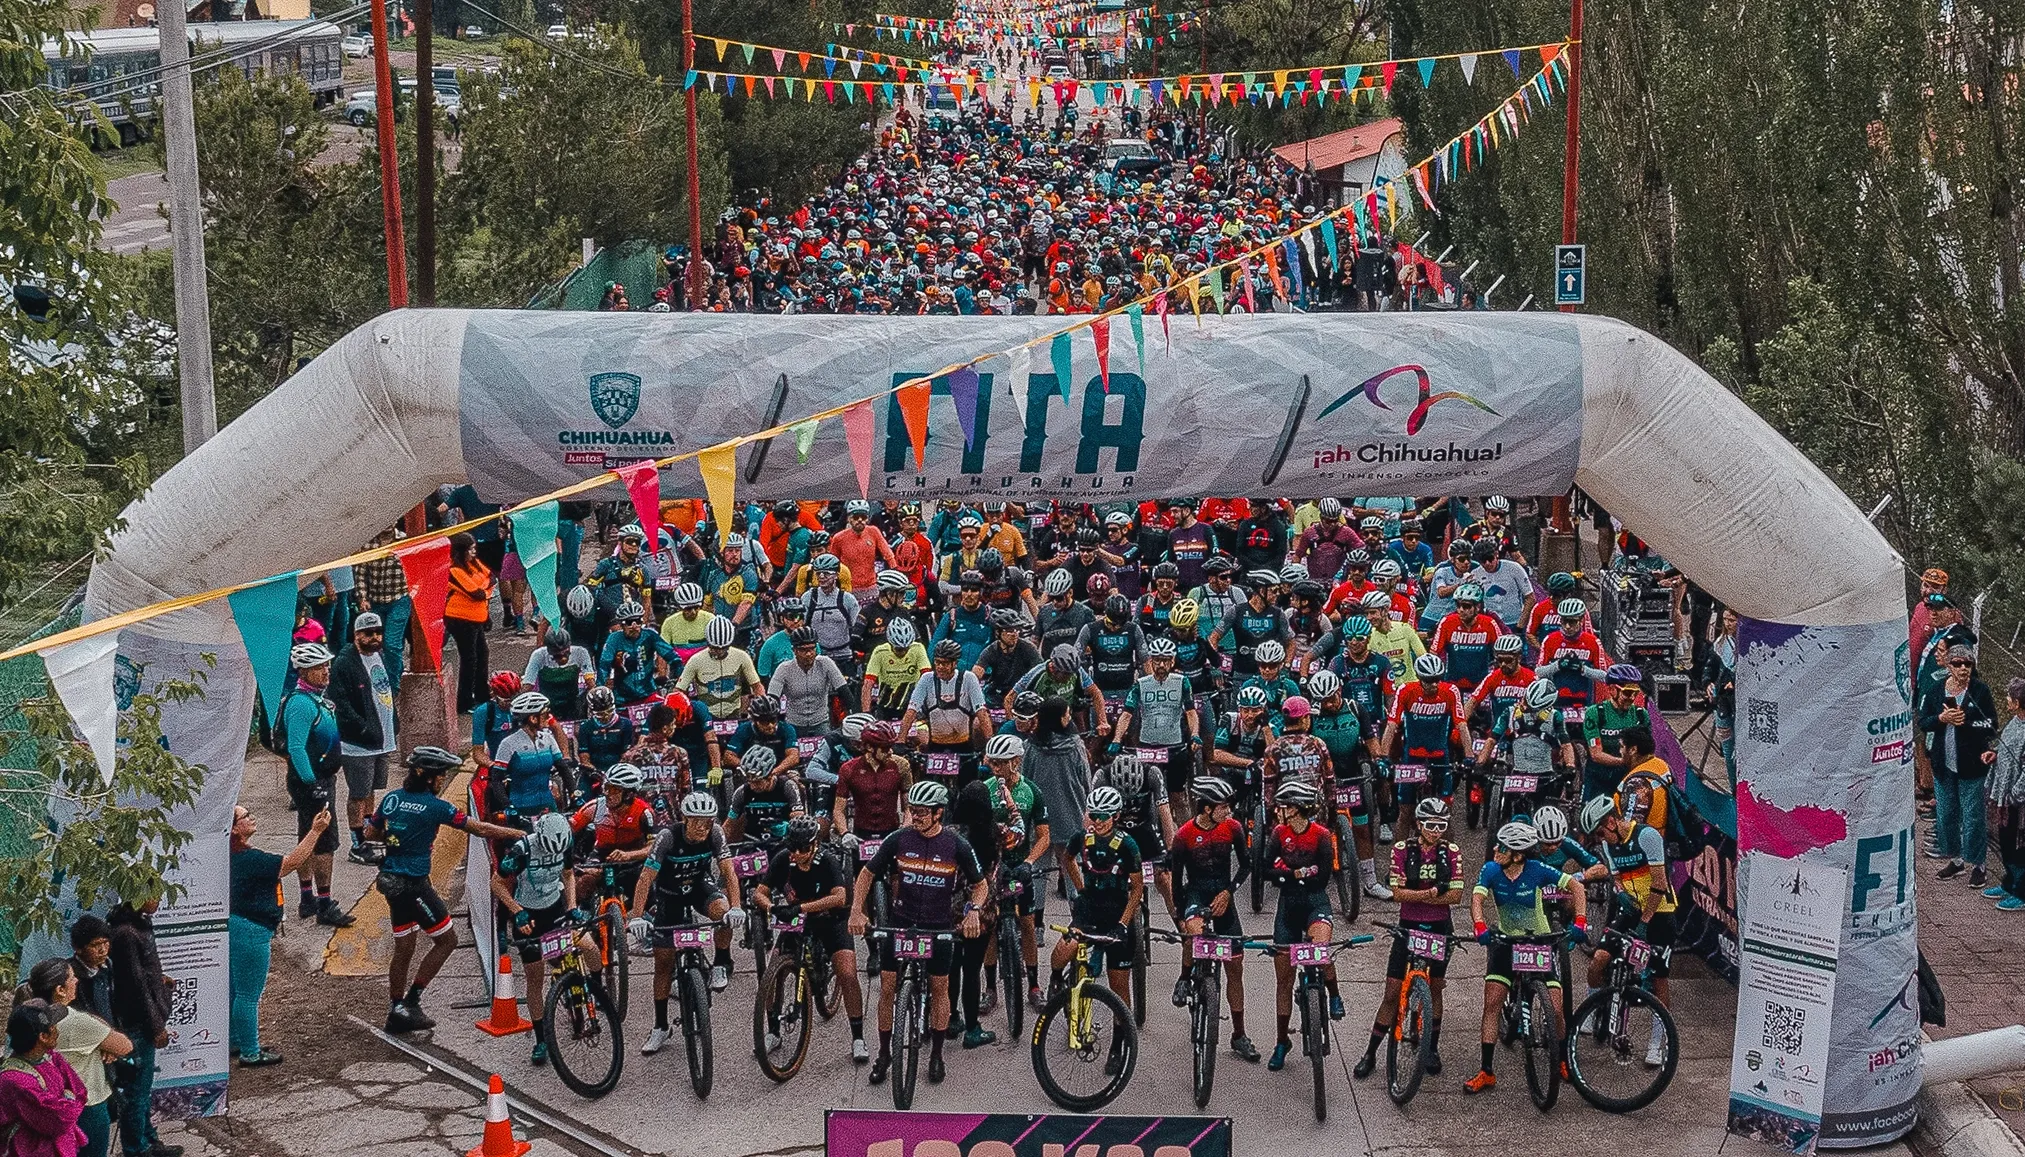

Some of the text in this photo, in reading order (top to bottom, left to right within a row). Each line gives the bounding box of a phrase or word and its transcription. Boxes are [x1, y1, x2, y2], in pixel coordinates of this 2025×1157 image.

[884, 372, 1146, 474] FITA
[558, 431, 675, 445] CHIHUAHUA
[567, 454, 603, 463] Juntos
[1313, 442, 1502, 468] ¡ah Chihuahua!
[619, 459, 672, 470] pods
[885, 475, 1135, 489] CHIHUAHUA
[1451, 631, 1488, 644] ANTIPRO
[1554, 648, 1591, 661] ANTPRO
[1144, 689, 1178, 703] DBC
[1410, 702, 1447, 715] ANTIPRO
[1601, 728, 1622, 736] cron
[1874, 744, 1903, 761] Juntos
[1279, 754, 1321, 772] STAFF
[1852, 824, 1914, 914] FI
[917, 874, 945, 885] DACZA
[1773, 900, 1814, 917] CREEL
[1415, 937, 1428, 950] 63
[1297, 949, 1310, 960] 34
[1519, 952, 1534, 964] 124
